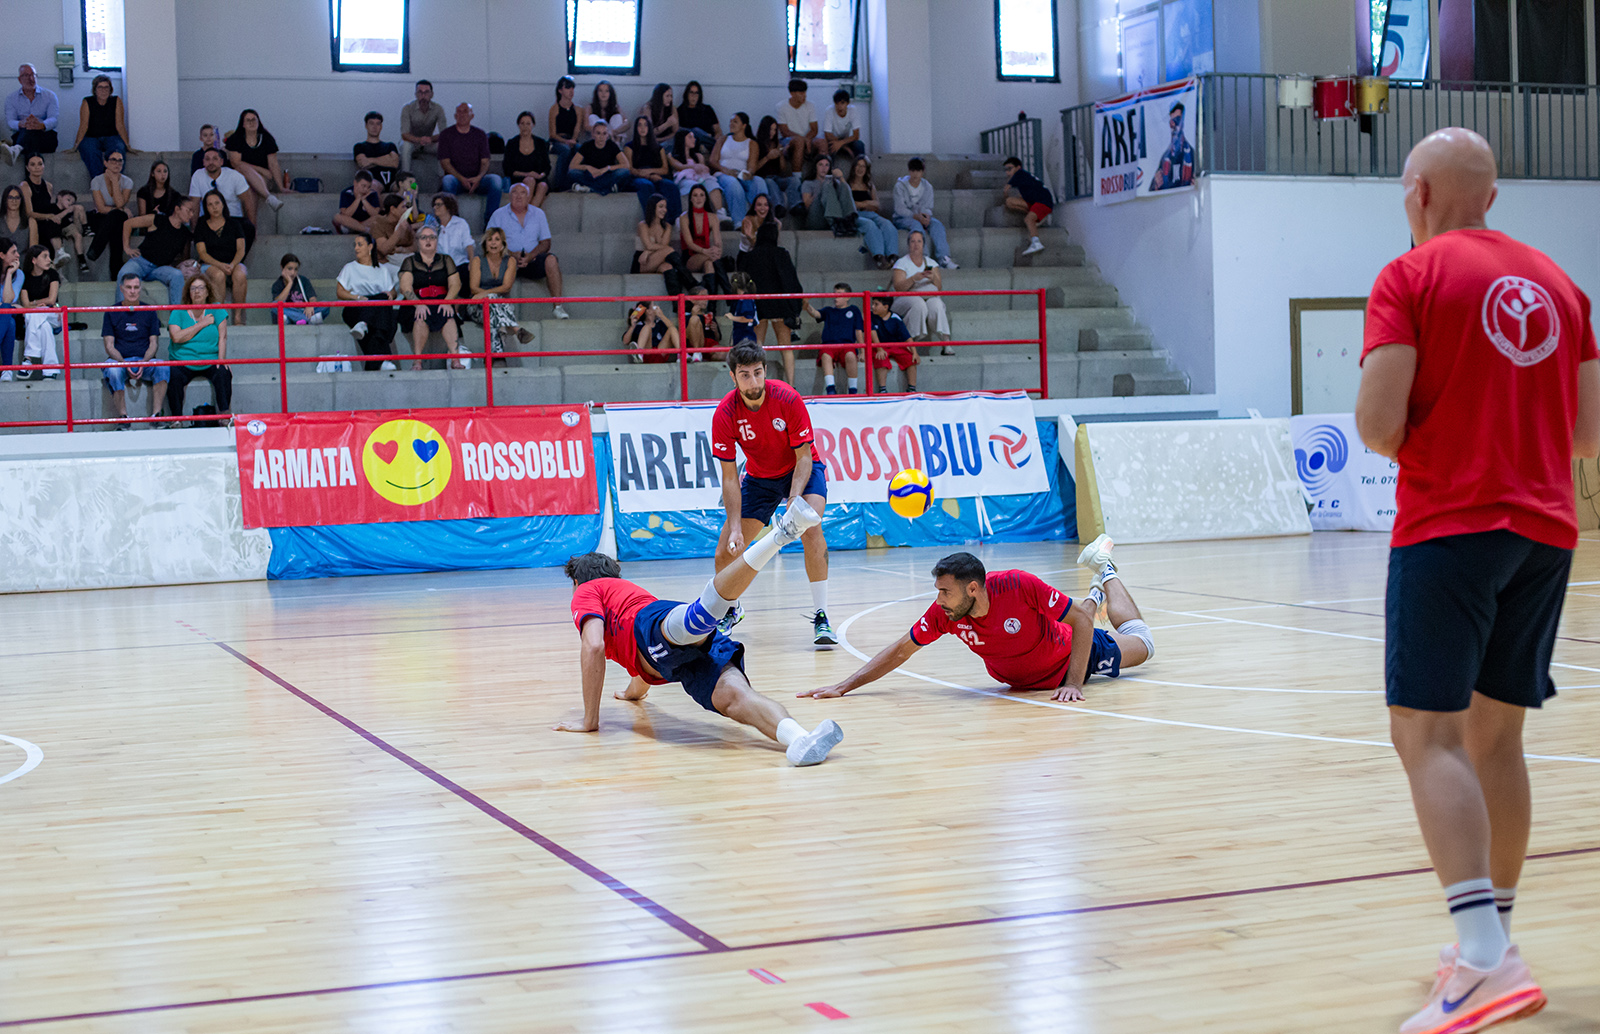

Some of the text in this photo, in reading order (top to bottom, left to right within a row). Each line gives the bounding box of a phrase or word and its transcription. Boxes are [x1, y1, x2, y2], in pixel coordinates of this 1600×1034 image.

[738, 424, 756, 441] 15
[619, 421, 983, 491] AREA ROSSOBLU
[253, 440, 586, 490] ARMATA ROSSOBLU
[1361, 475, 1377, 485] Tel.
[960, 630, 986, 646] 12
